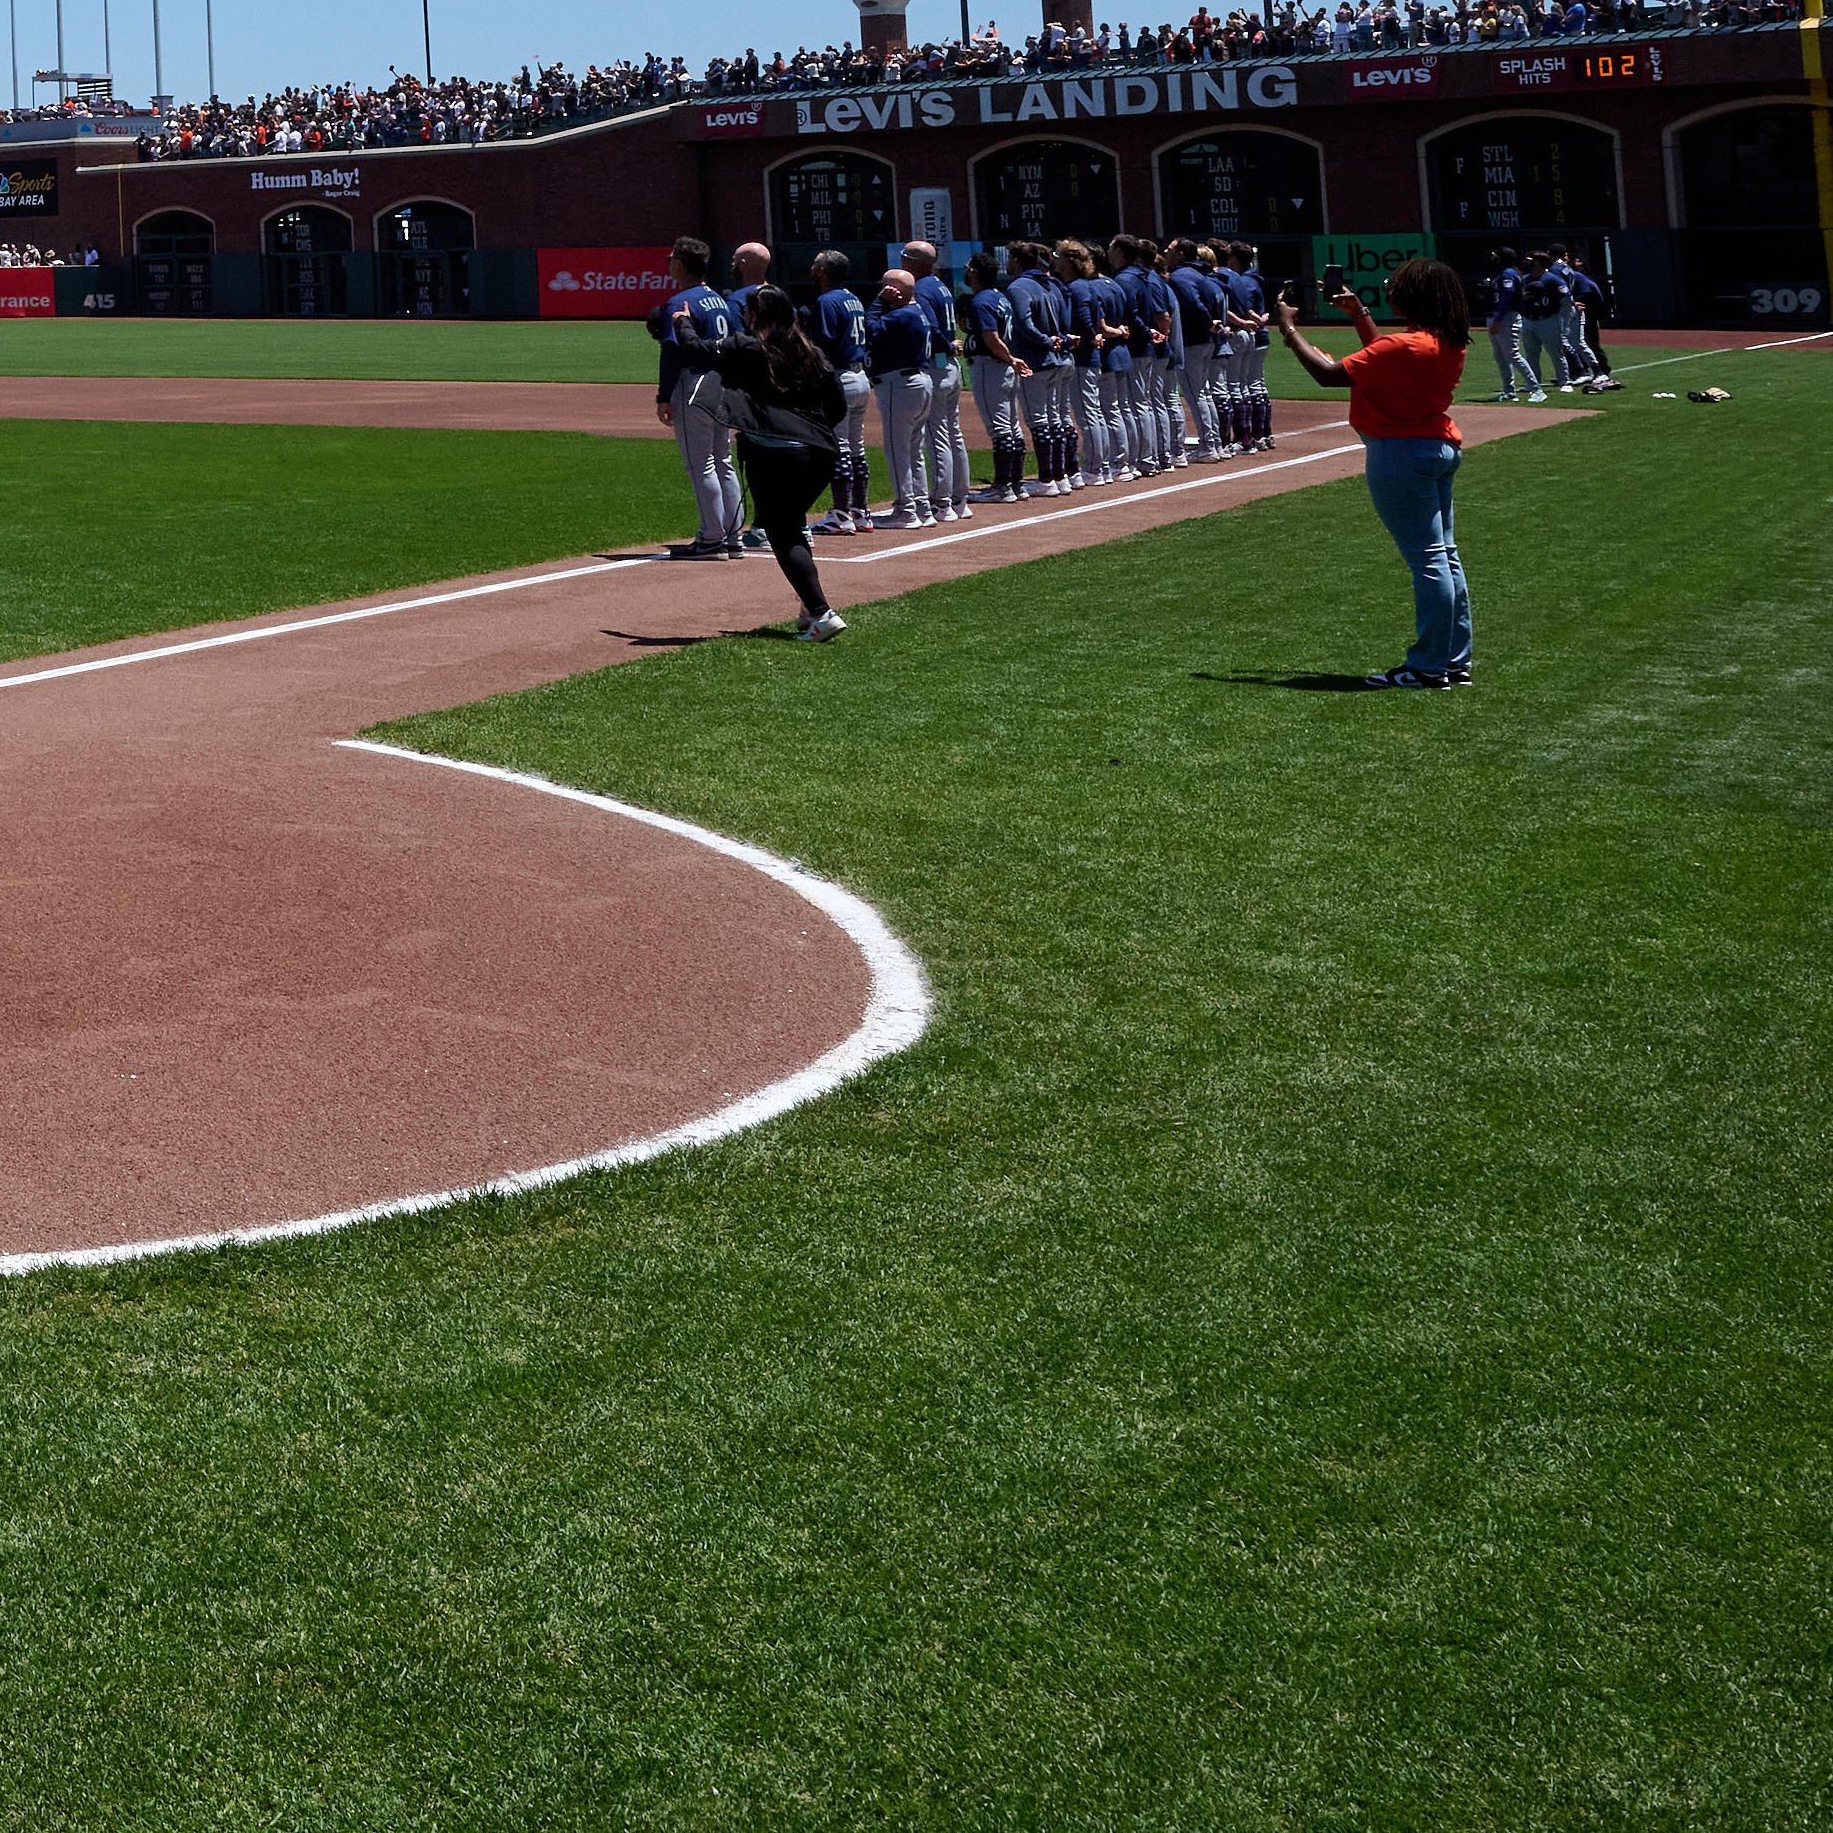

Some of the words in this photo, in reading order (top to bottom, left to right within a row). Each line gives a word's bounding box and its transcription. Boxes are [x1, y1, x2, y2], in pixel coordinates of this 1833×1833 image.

[1500, 58, 1565, 73] SPLASH
[1585, 56, 1634, 77] 102
[1519, 73, 1550, 85] HITS
[981, 66, 1299, 123] LANDING
[94, 121, 129, 135] Coors
[1482, 145, 1513, 162] STL
[1208, 158, 1234, 173] LAA
[251, 173, 307, 190] Humm
[311, 167, 360, 187] Baby!
[811, 174, 829, 187] CHI
[1485, 166, 1515, 183] MIA
[8, 171, 55, 195] Sports
[1024, 183, 1041, 198] AZ
[1214, 177, 1231, 192] SD
[19, 194, 45, 206] AREA
[811, 191, 831, 205] MIL
[1487, 190, 1517, 206] CIN
[1021, 204, 1045, 219] PIT
[1210, 198, 1238, 214] COL
[813, 210, 830, 224] PHI
[1488, 212, 1519, 227] WSH
[1027, 222, 1041, 237] LA
[1212, 217, 1239, 233] HOU
[84, 294, 115, 308] 415
[1751, 288, 1821, 313] 309
[716, 314, 727, 339] 9
